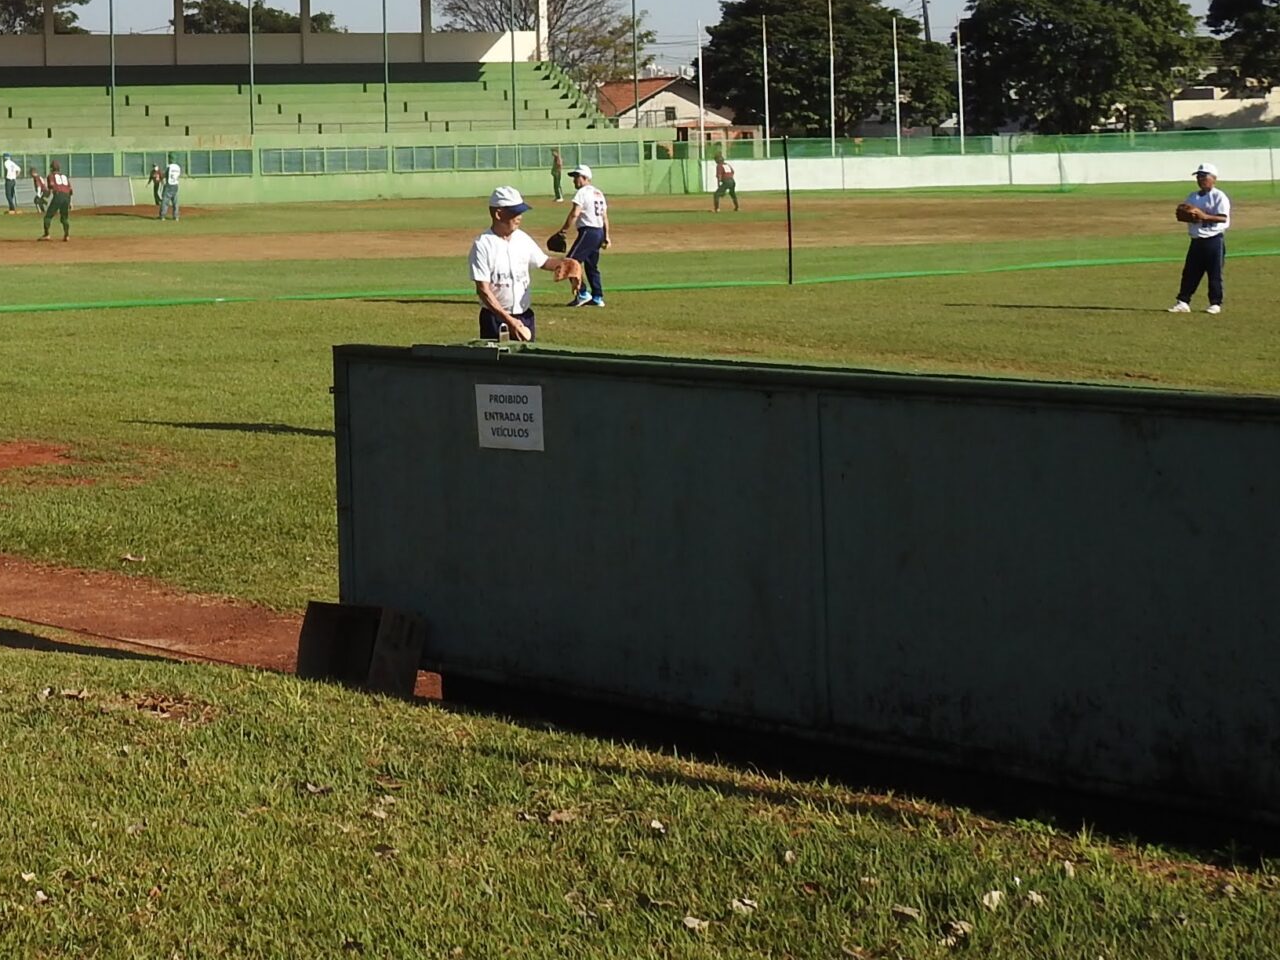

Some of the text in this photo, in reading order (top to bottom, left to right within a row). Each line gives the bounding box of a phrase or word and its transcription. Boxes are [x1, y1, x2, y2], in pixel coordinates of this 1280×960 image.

[489, 394, 529, 405] PROIBIDO
[484, 411, 535, 423] ENTRADA DE
[491, 425, 529, 438] VEÍCULOS
